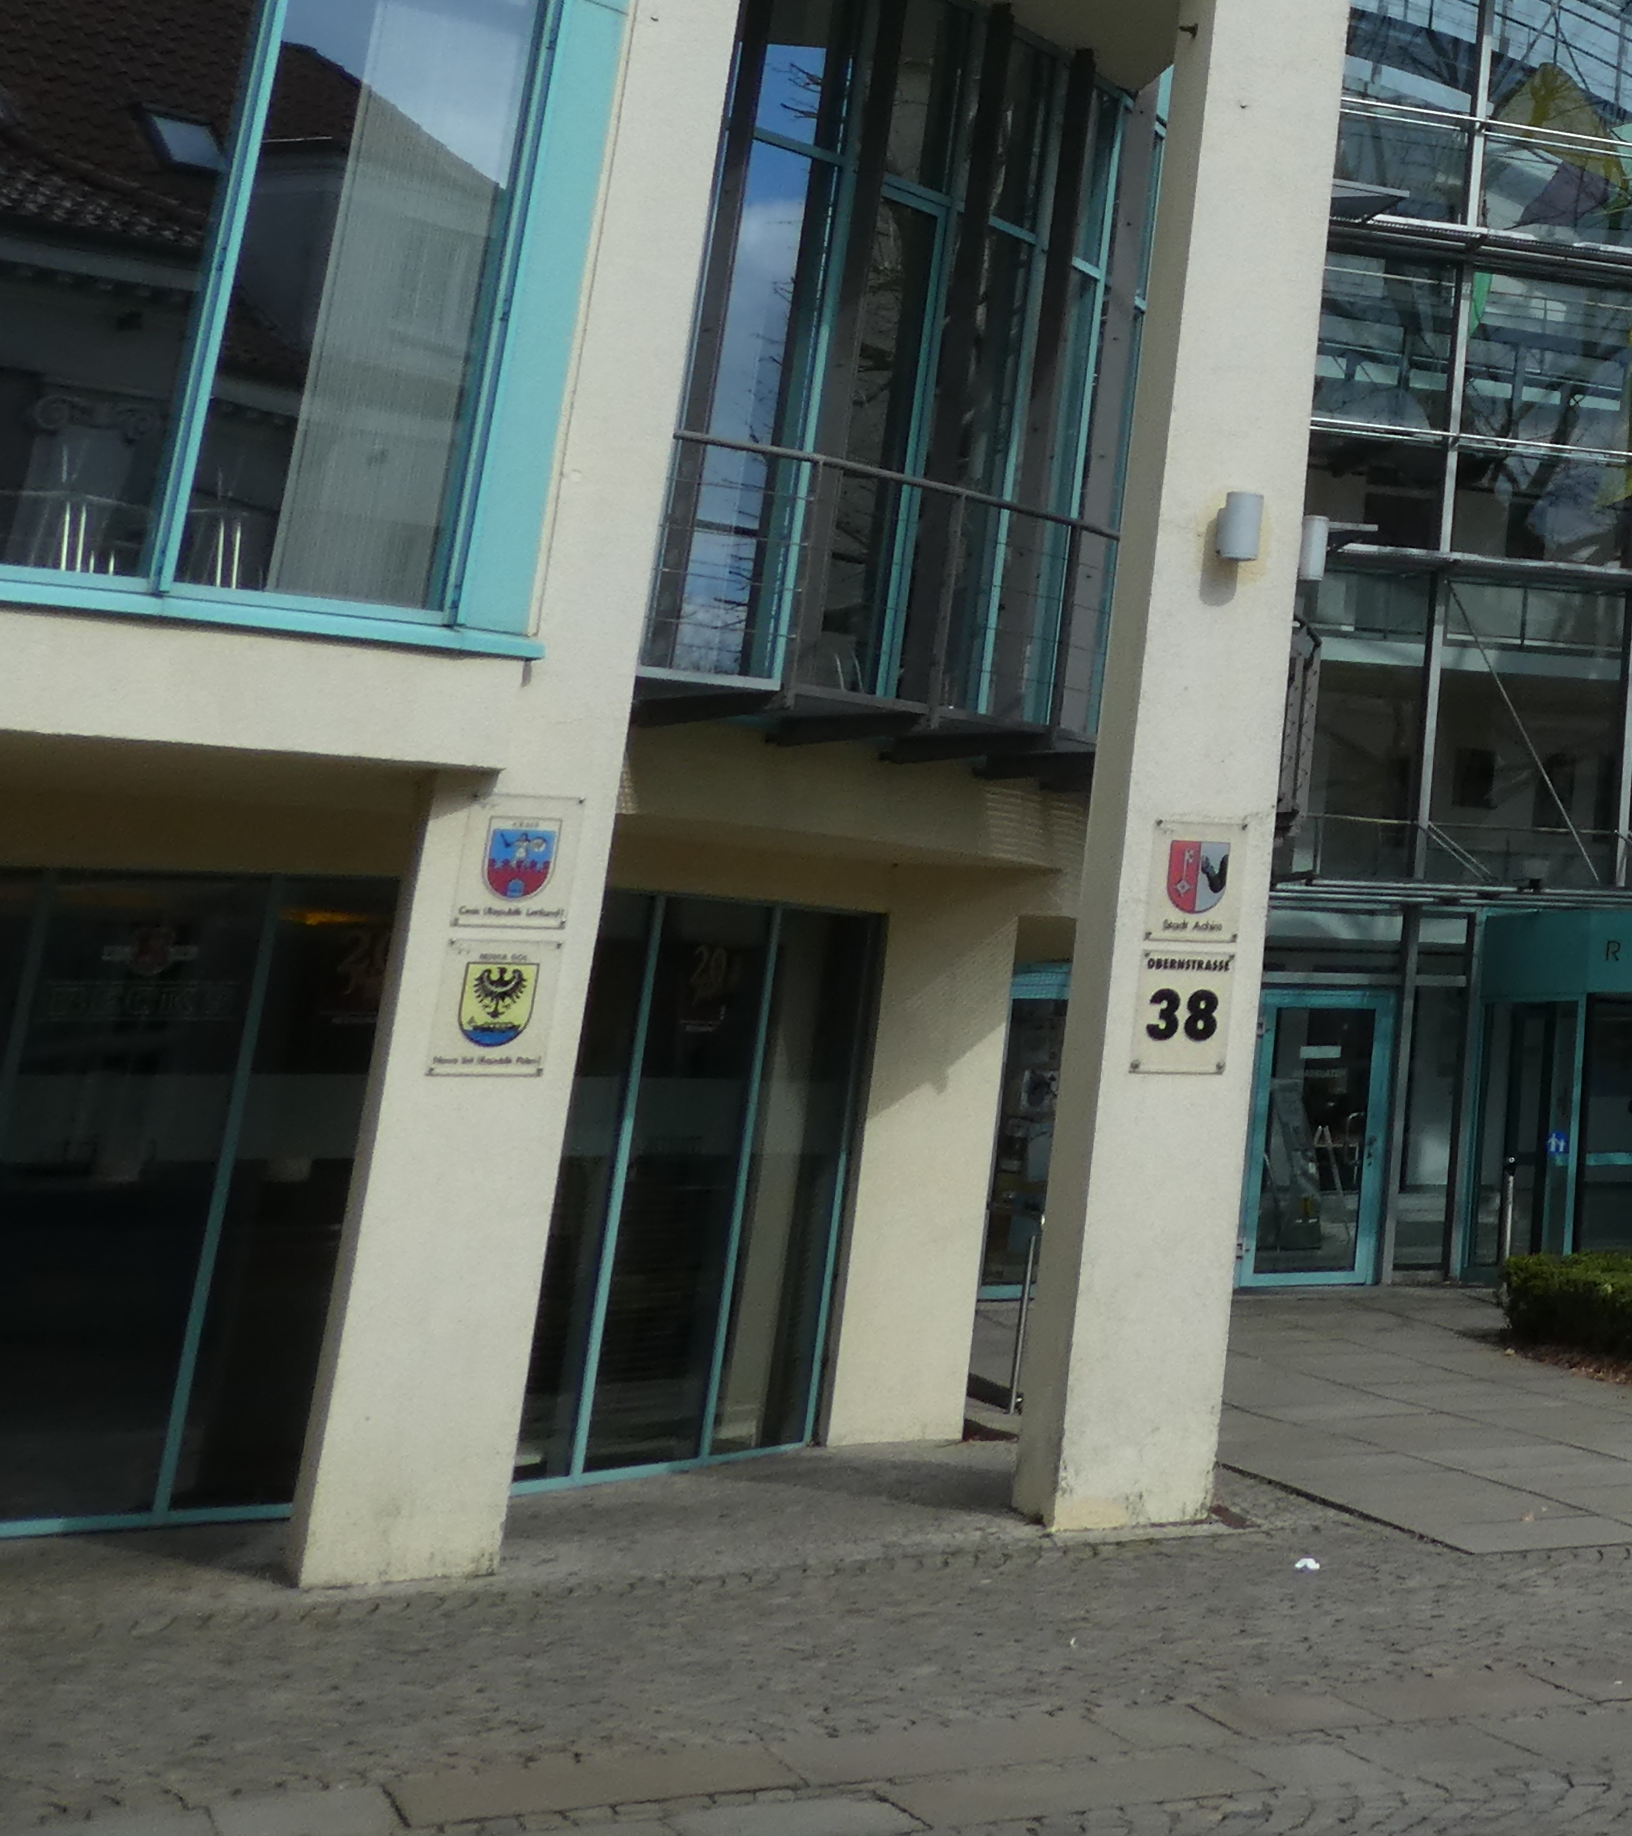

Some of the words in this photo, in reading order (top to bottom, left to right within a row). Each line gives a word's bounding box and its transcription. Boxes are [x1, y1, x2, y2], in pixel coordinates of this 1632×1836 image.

[1162, 919, 1188, 931] Stadt
[1192, 920, 1223, 932] Achim
[1147, 957, 1231, 972] OBERNSTRASSE
[1146, 988, 1219, 1042] 38
